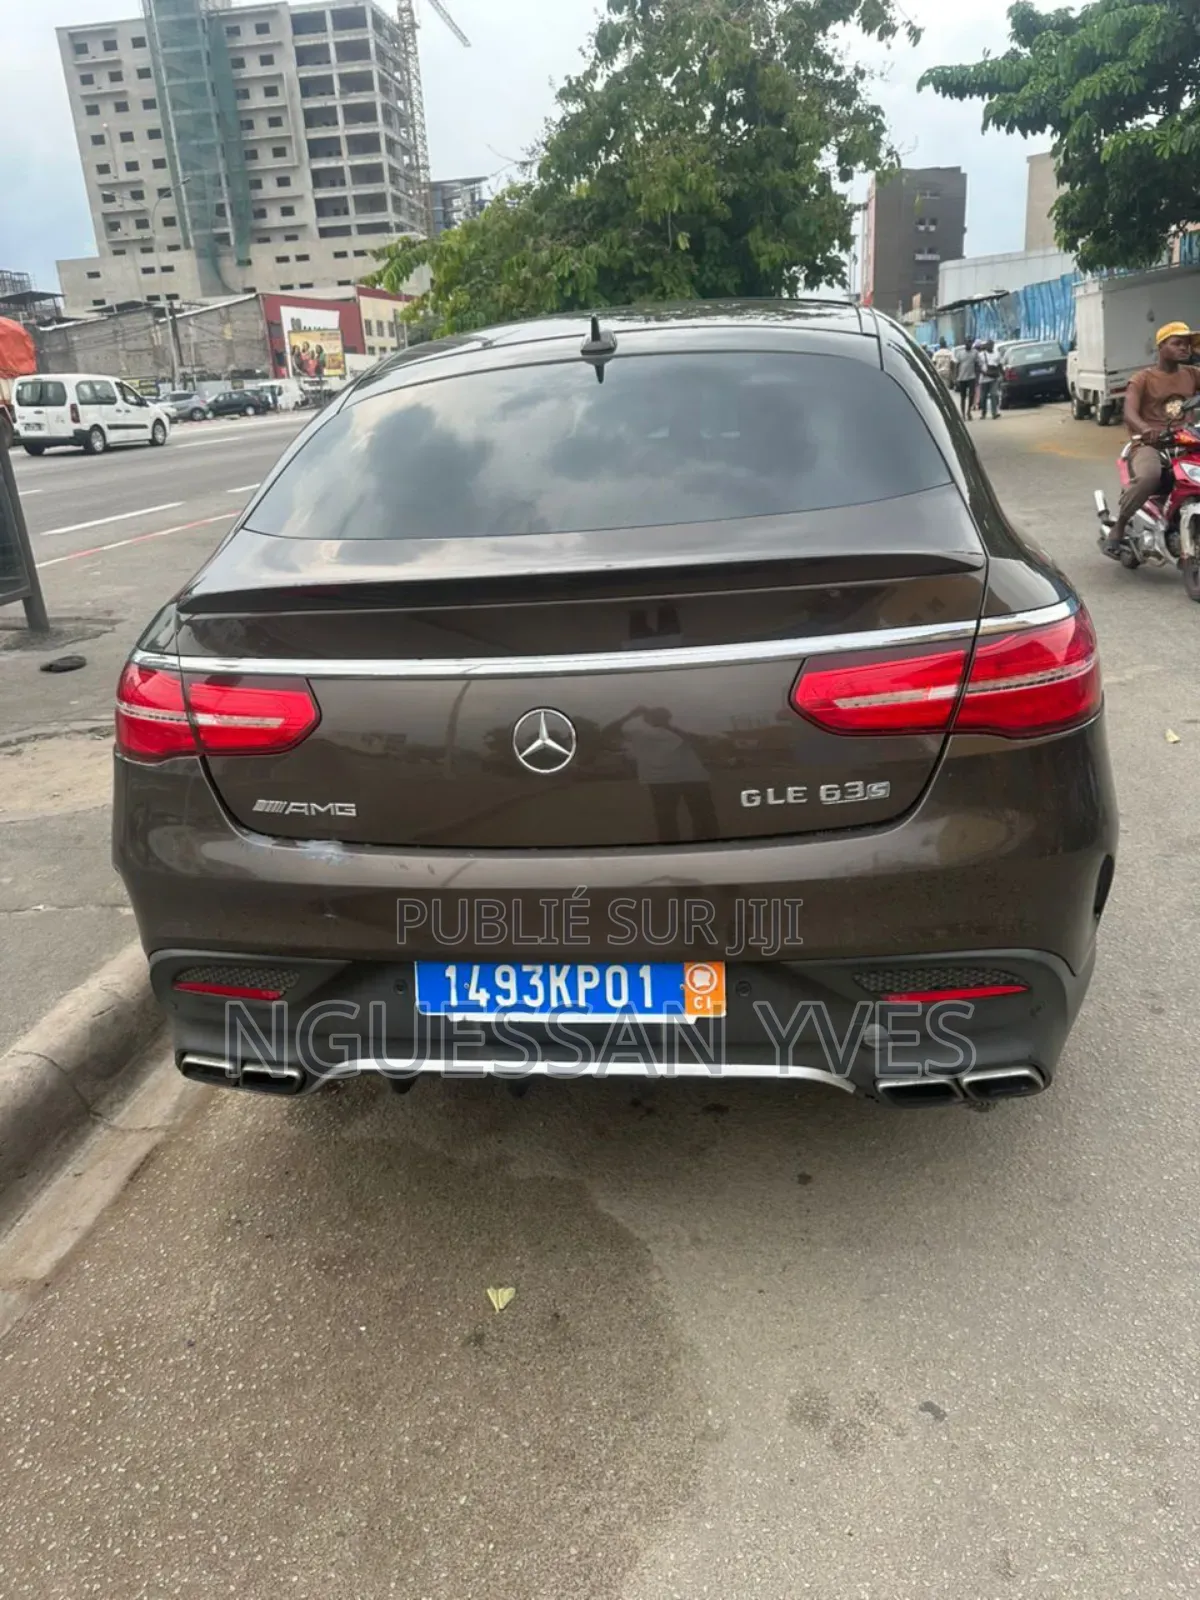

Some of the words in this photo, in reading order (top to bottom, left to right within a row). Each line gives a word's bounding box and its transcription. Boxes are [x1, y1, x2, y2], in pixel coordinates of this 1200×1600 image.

[740, 786, 809, 808] GLE
[284, 801, 357, 817] AMG
[444, 963, 653, 1009] 1493KP01
[693, 995, 712, 1010] CI
